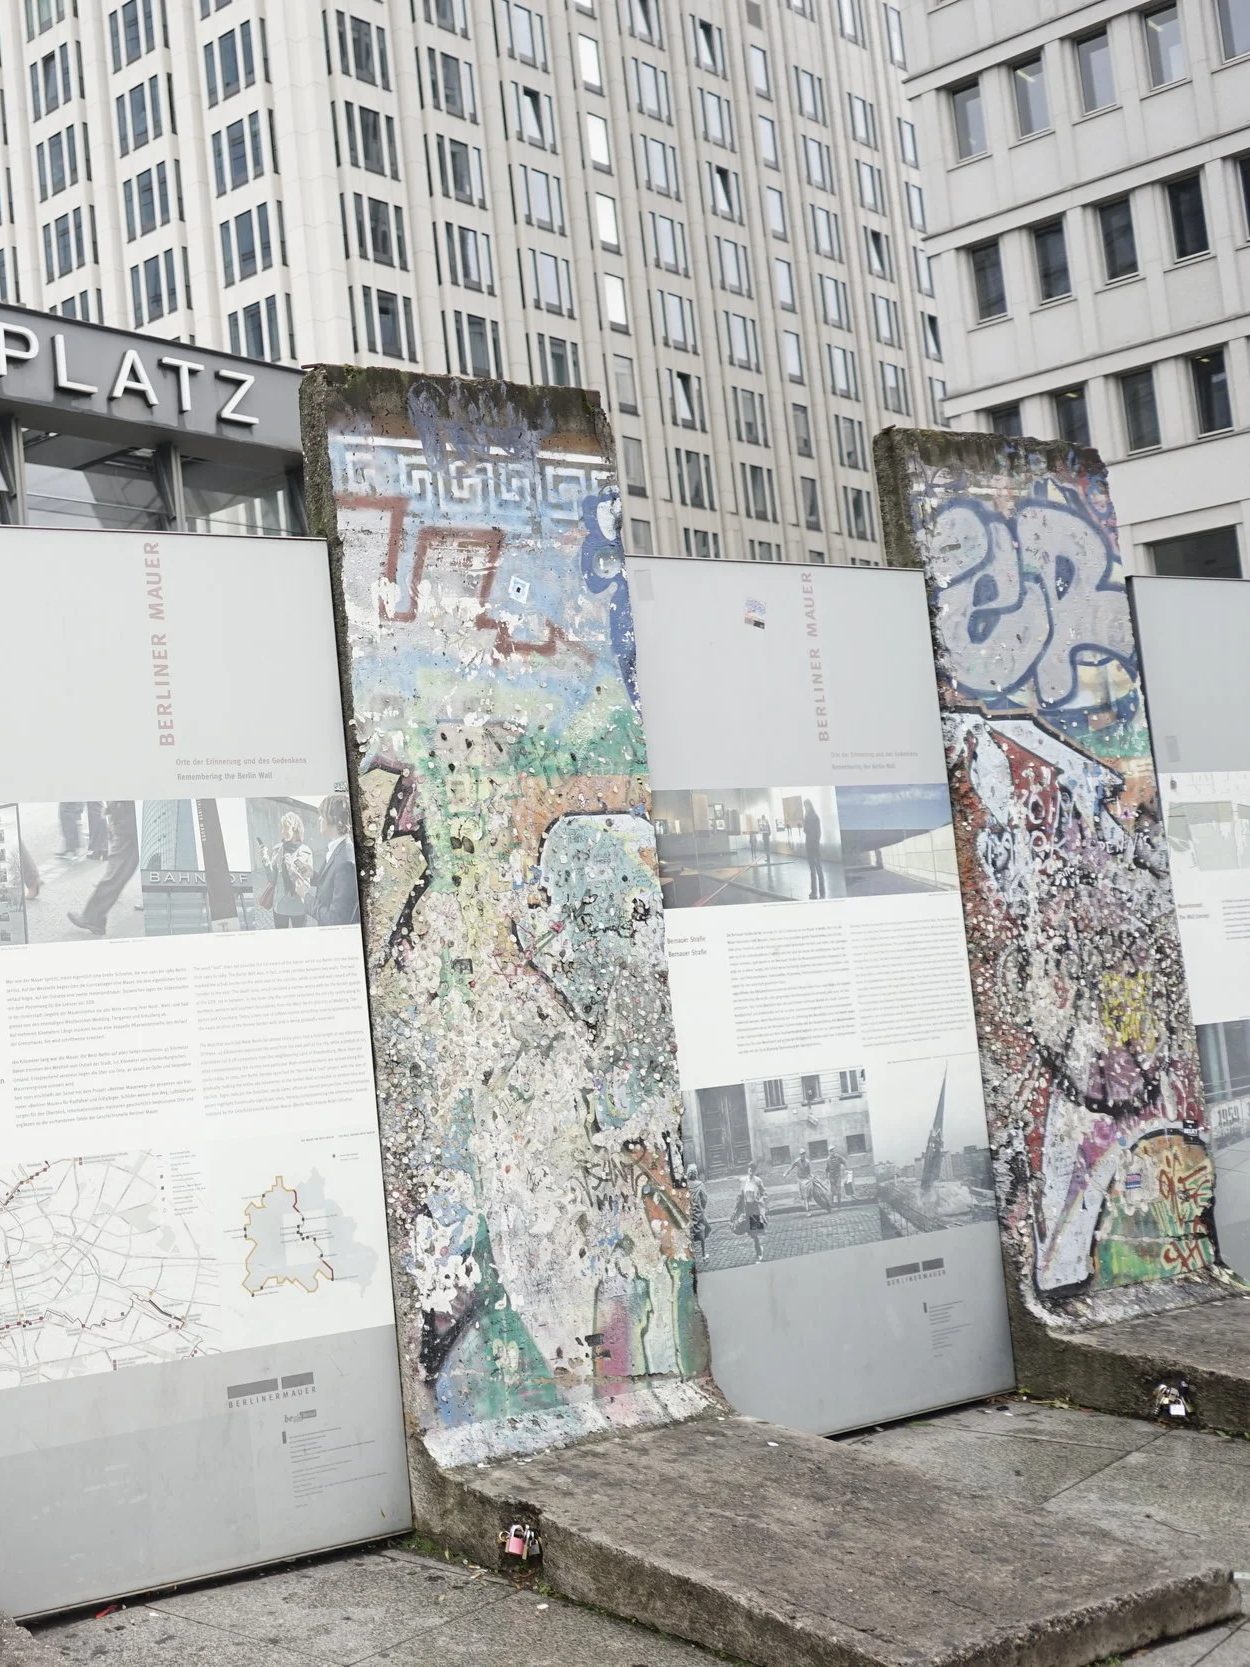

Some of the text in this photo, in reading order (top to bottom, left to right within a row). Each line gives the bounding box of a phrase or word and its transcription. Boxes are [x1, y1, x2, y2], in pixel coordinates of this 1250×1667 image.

[143, 541, 175, 746] BERLINER MAUER
[801, 572, 830, 742] BERLINER MAUER
[176, 758, 190, 766] Orte
[206, 758, 241, 766] Erinnerung
[228, 1386, 317, 1409] BERLINERMAUER
